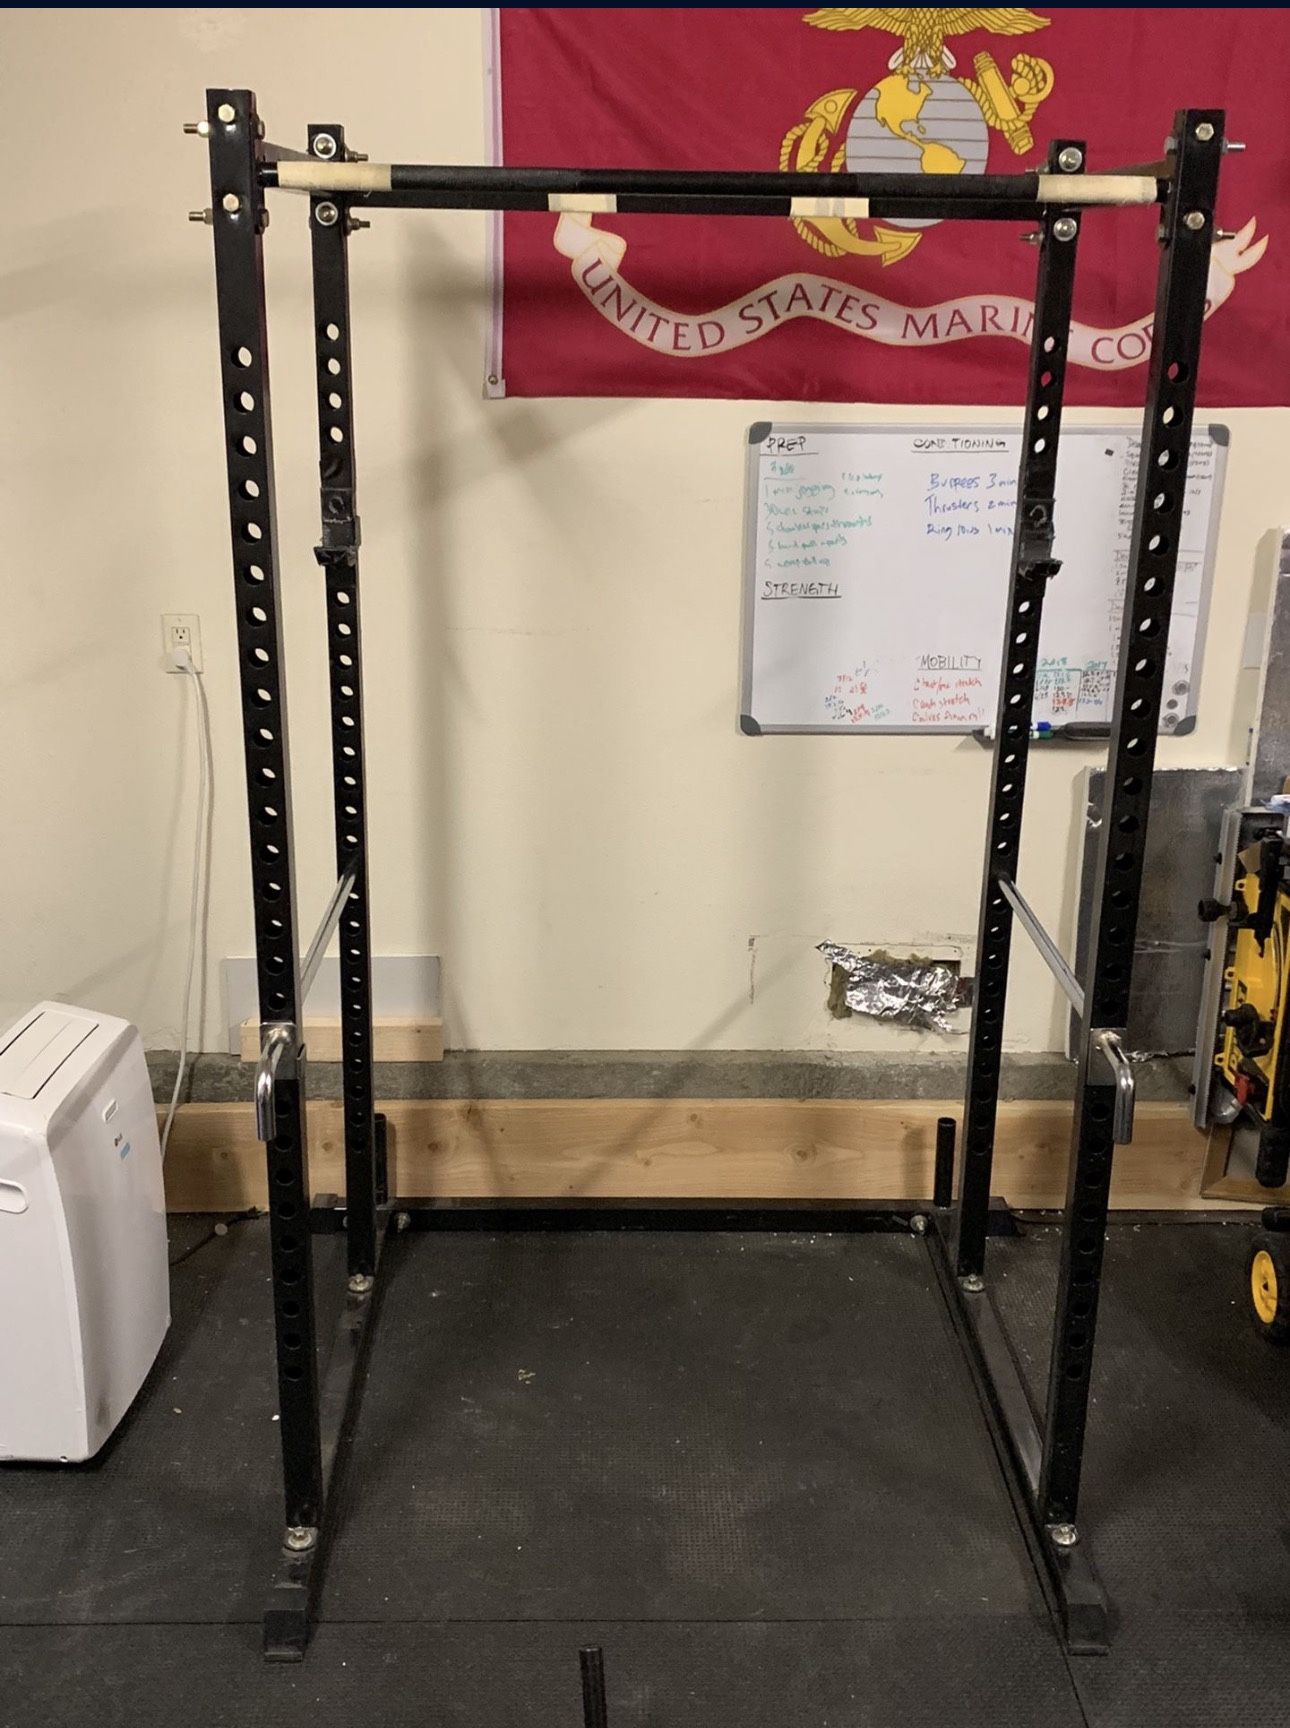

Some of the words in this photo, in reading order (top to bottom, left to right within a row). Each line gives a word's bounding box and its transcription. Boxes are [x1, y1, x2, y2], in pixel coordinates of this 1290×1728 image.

[582, 258, 725, 351] UNITED
[738, 282, 881, 335] STATES
[766, 436, 806, 454] PREP
[986, 473, 997, 489] 3
[763, 580, 839, 597] STRENGTH
[920, 654, 982, 670] MOBILITY
